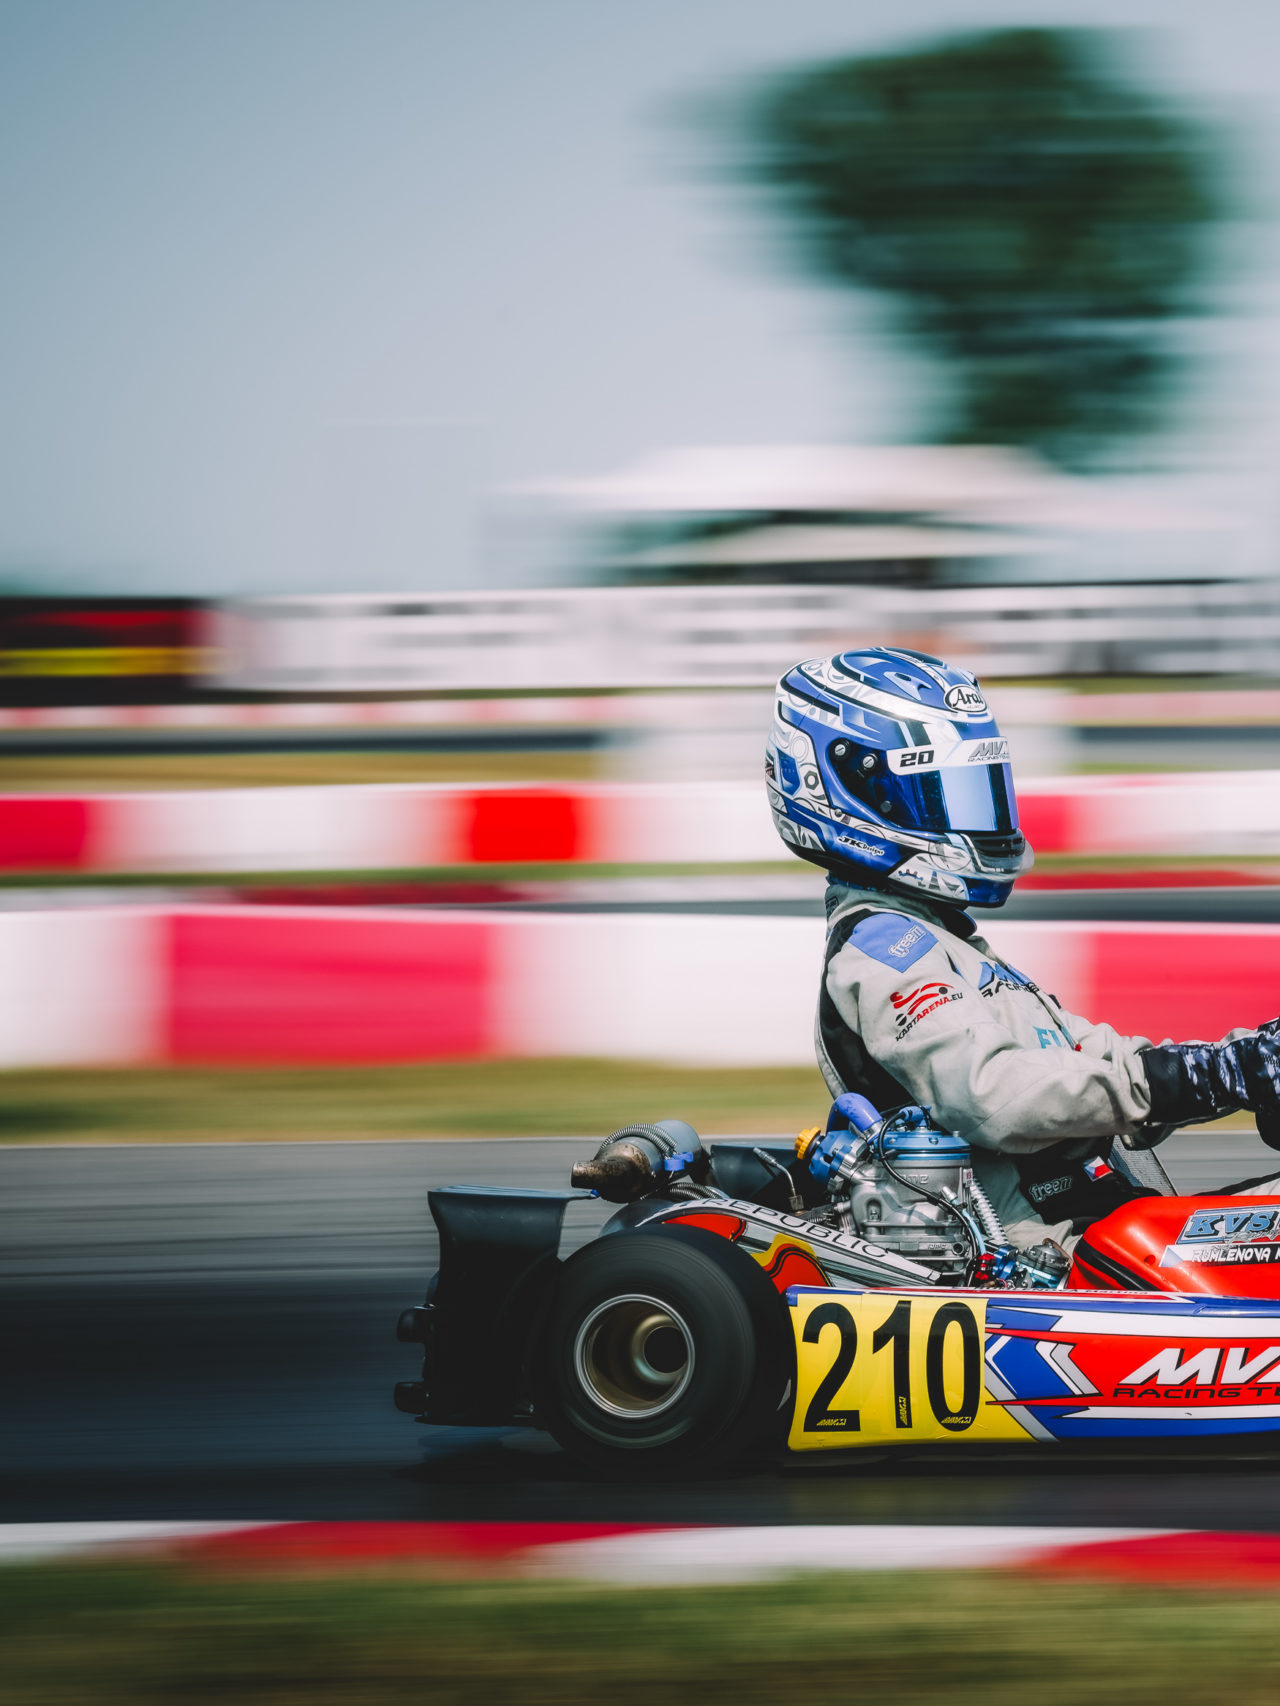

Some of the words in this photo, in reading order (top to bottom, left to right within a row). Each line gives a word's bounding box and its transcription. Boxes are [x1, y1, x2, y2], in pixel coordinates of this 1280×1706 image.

[900, 750, 934, 768] 20
[888, 924, 926, 957] freem
[1030, 1176, 1072, 1203] freem
[701, 1198, 889, 1259] REPUBLIC
[1184, 1210, 1280, 1238] KVS
[802, 1300, 981, 1433] 210
[1112, 1386, 1243, 1399] RACING
